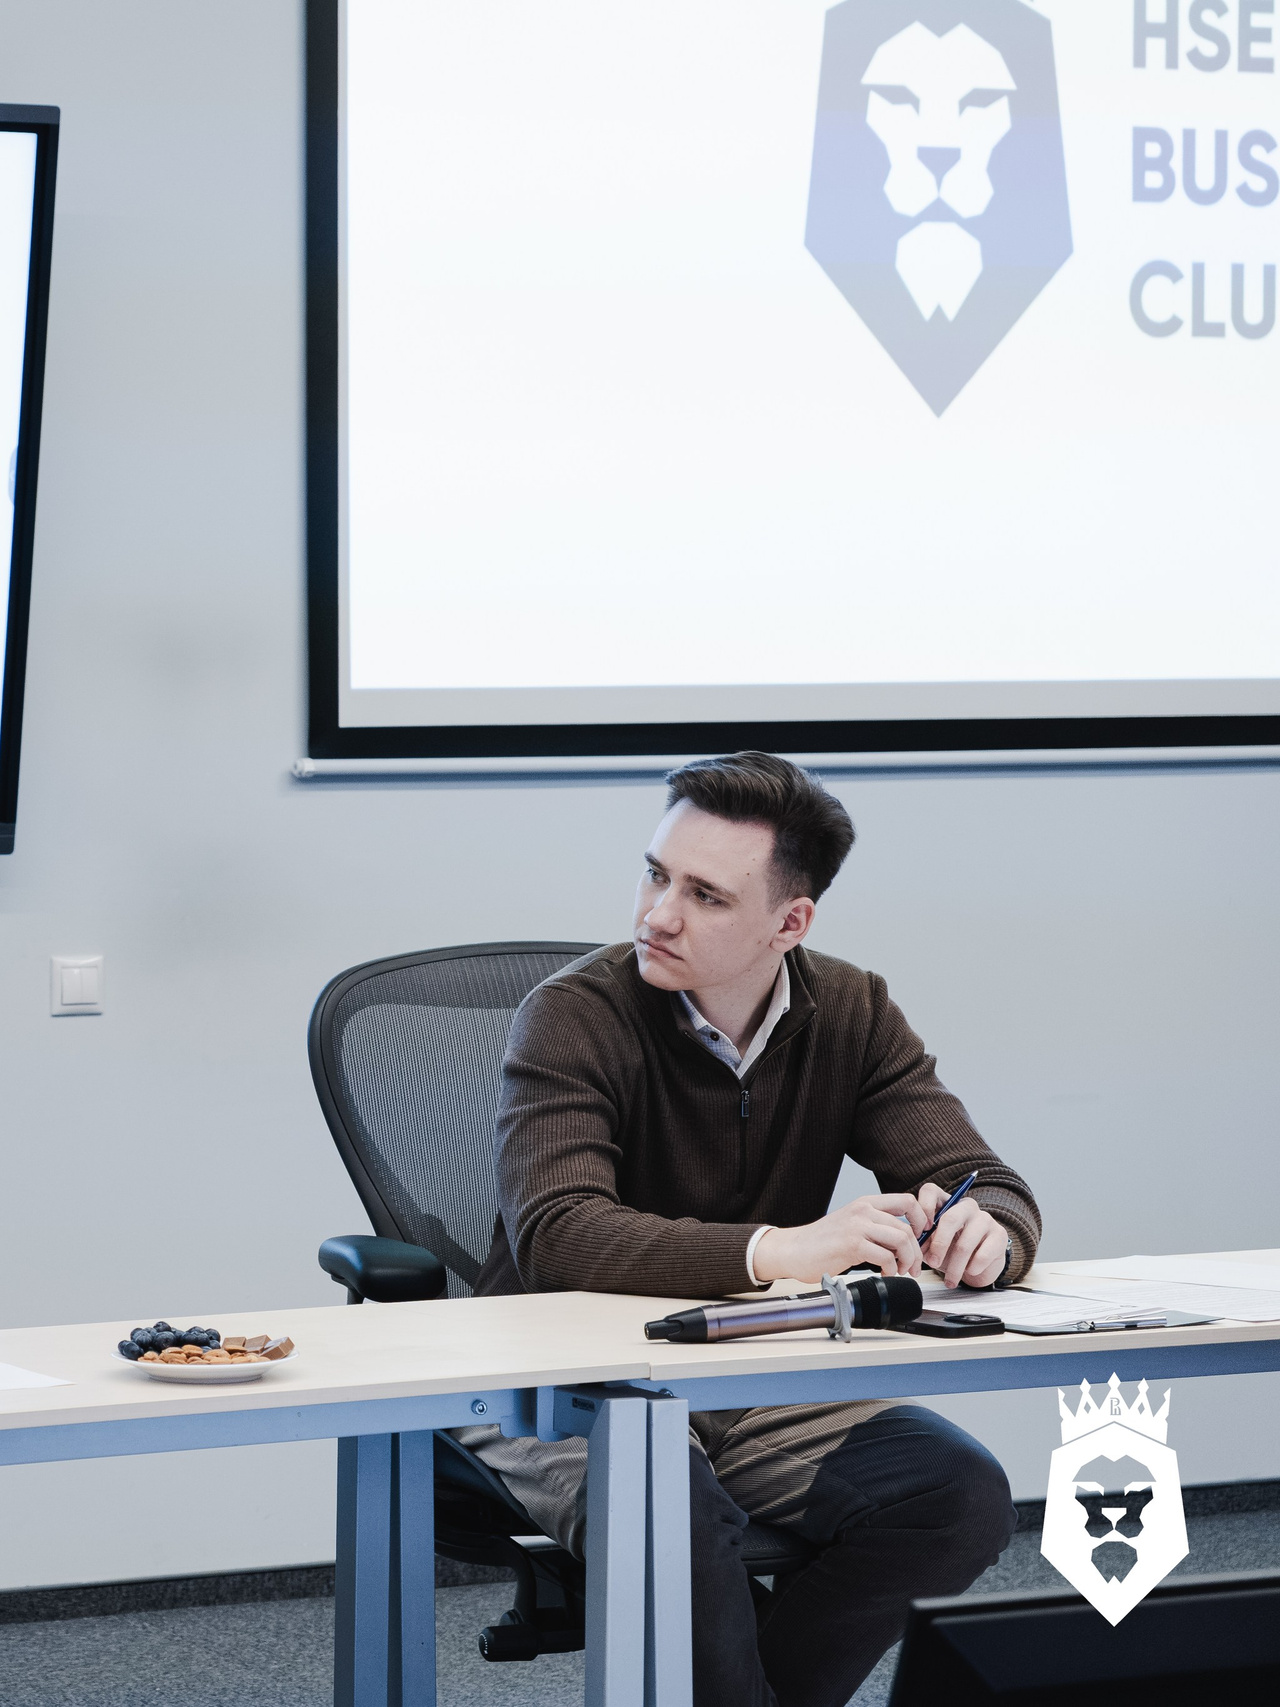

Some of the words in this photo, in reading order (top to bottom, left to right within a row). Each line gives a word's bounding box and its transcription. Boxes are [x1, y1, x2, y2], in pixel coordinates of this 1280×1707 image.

[1132, 0, 1276, 74] HSE
[1131, 126, 1280, 208] BUS
[1128, 260, 1276, 340] CLU
